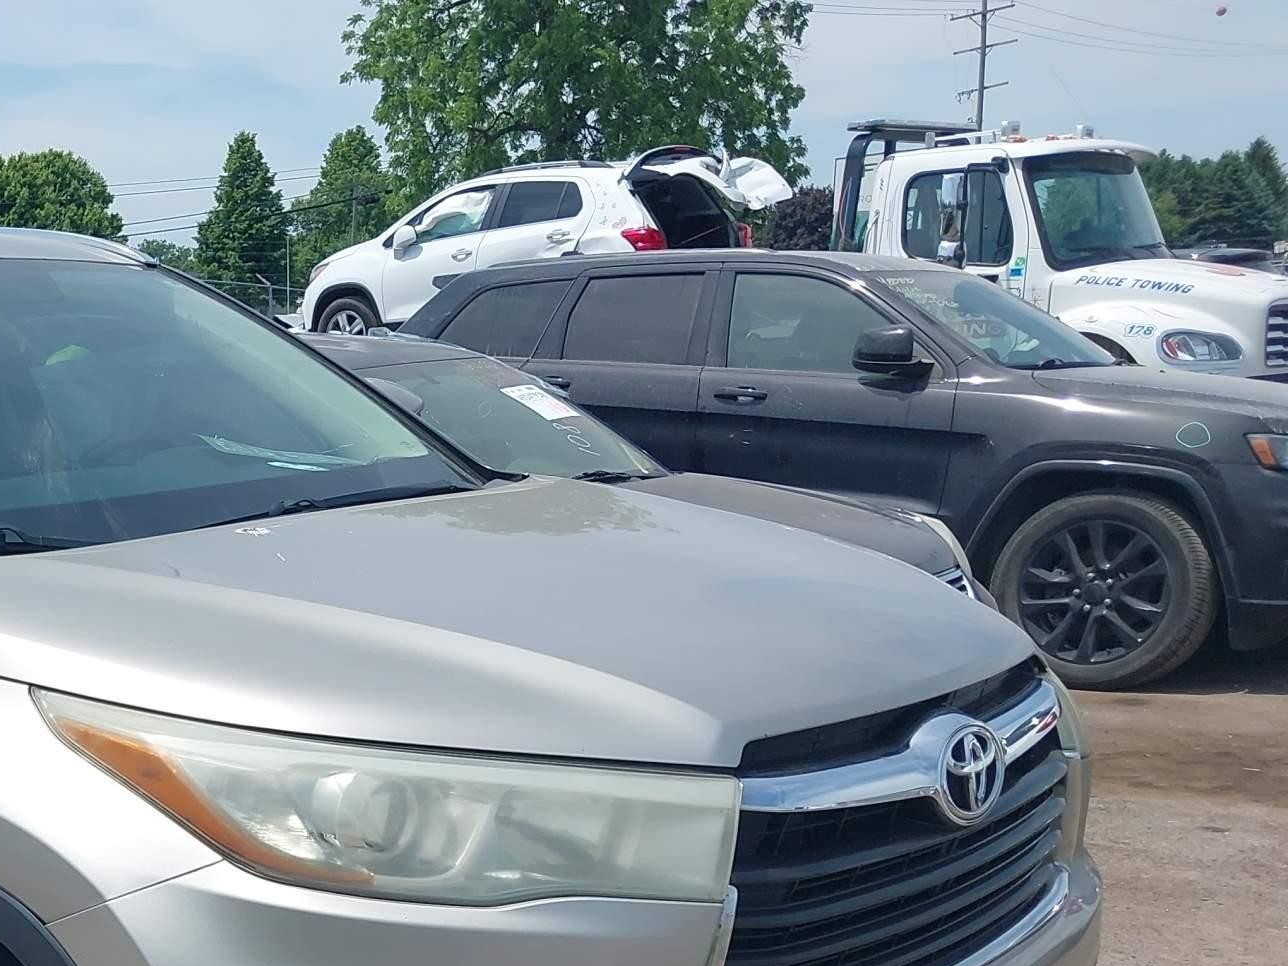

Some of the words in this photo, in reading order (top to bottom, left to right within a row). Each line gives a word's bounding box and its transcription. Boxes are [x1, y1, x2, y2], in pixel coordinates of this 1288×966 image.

[1075, 276, 1129, 288] POLICE
[1130, 279, 1195, 294] TOWING
[1127, 324, 1154, 336] 178
